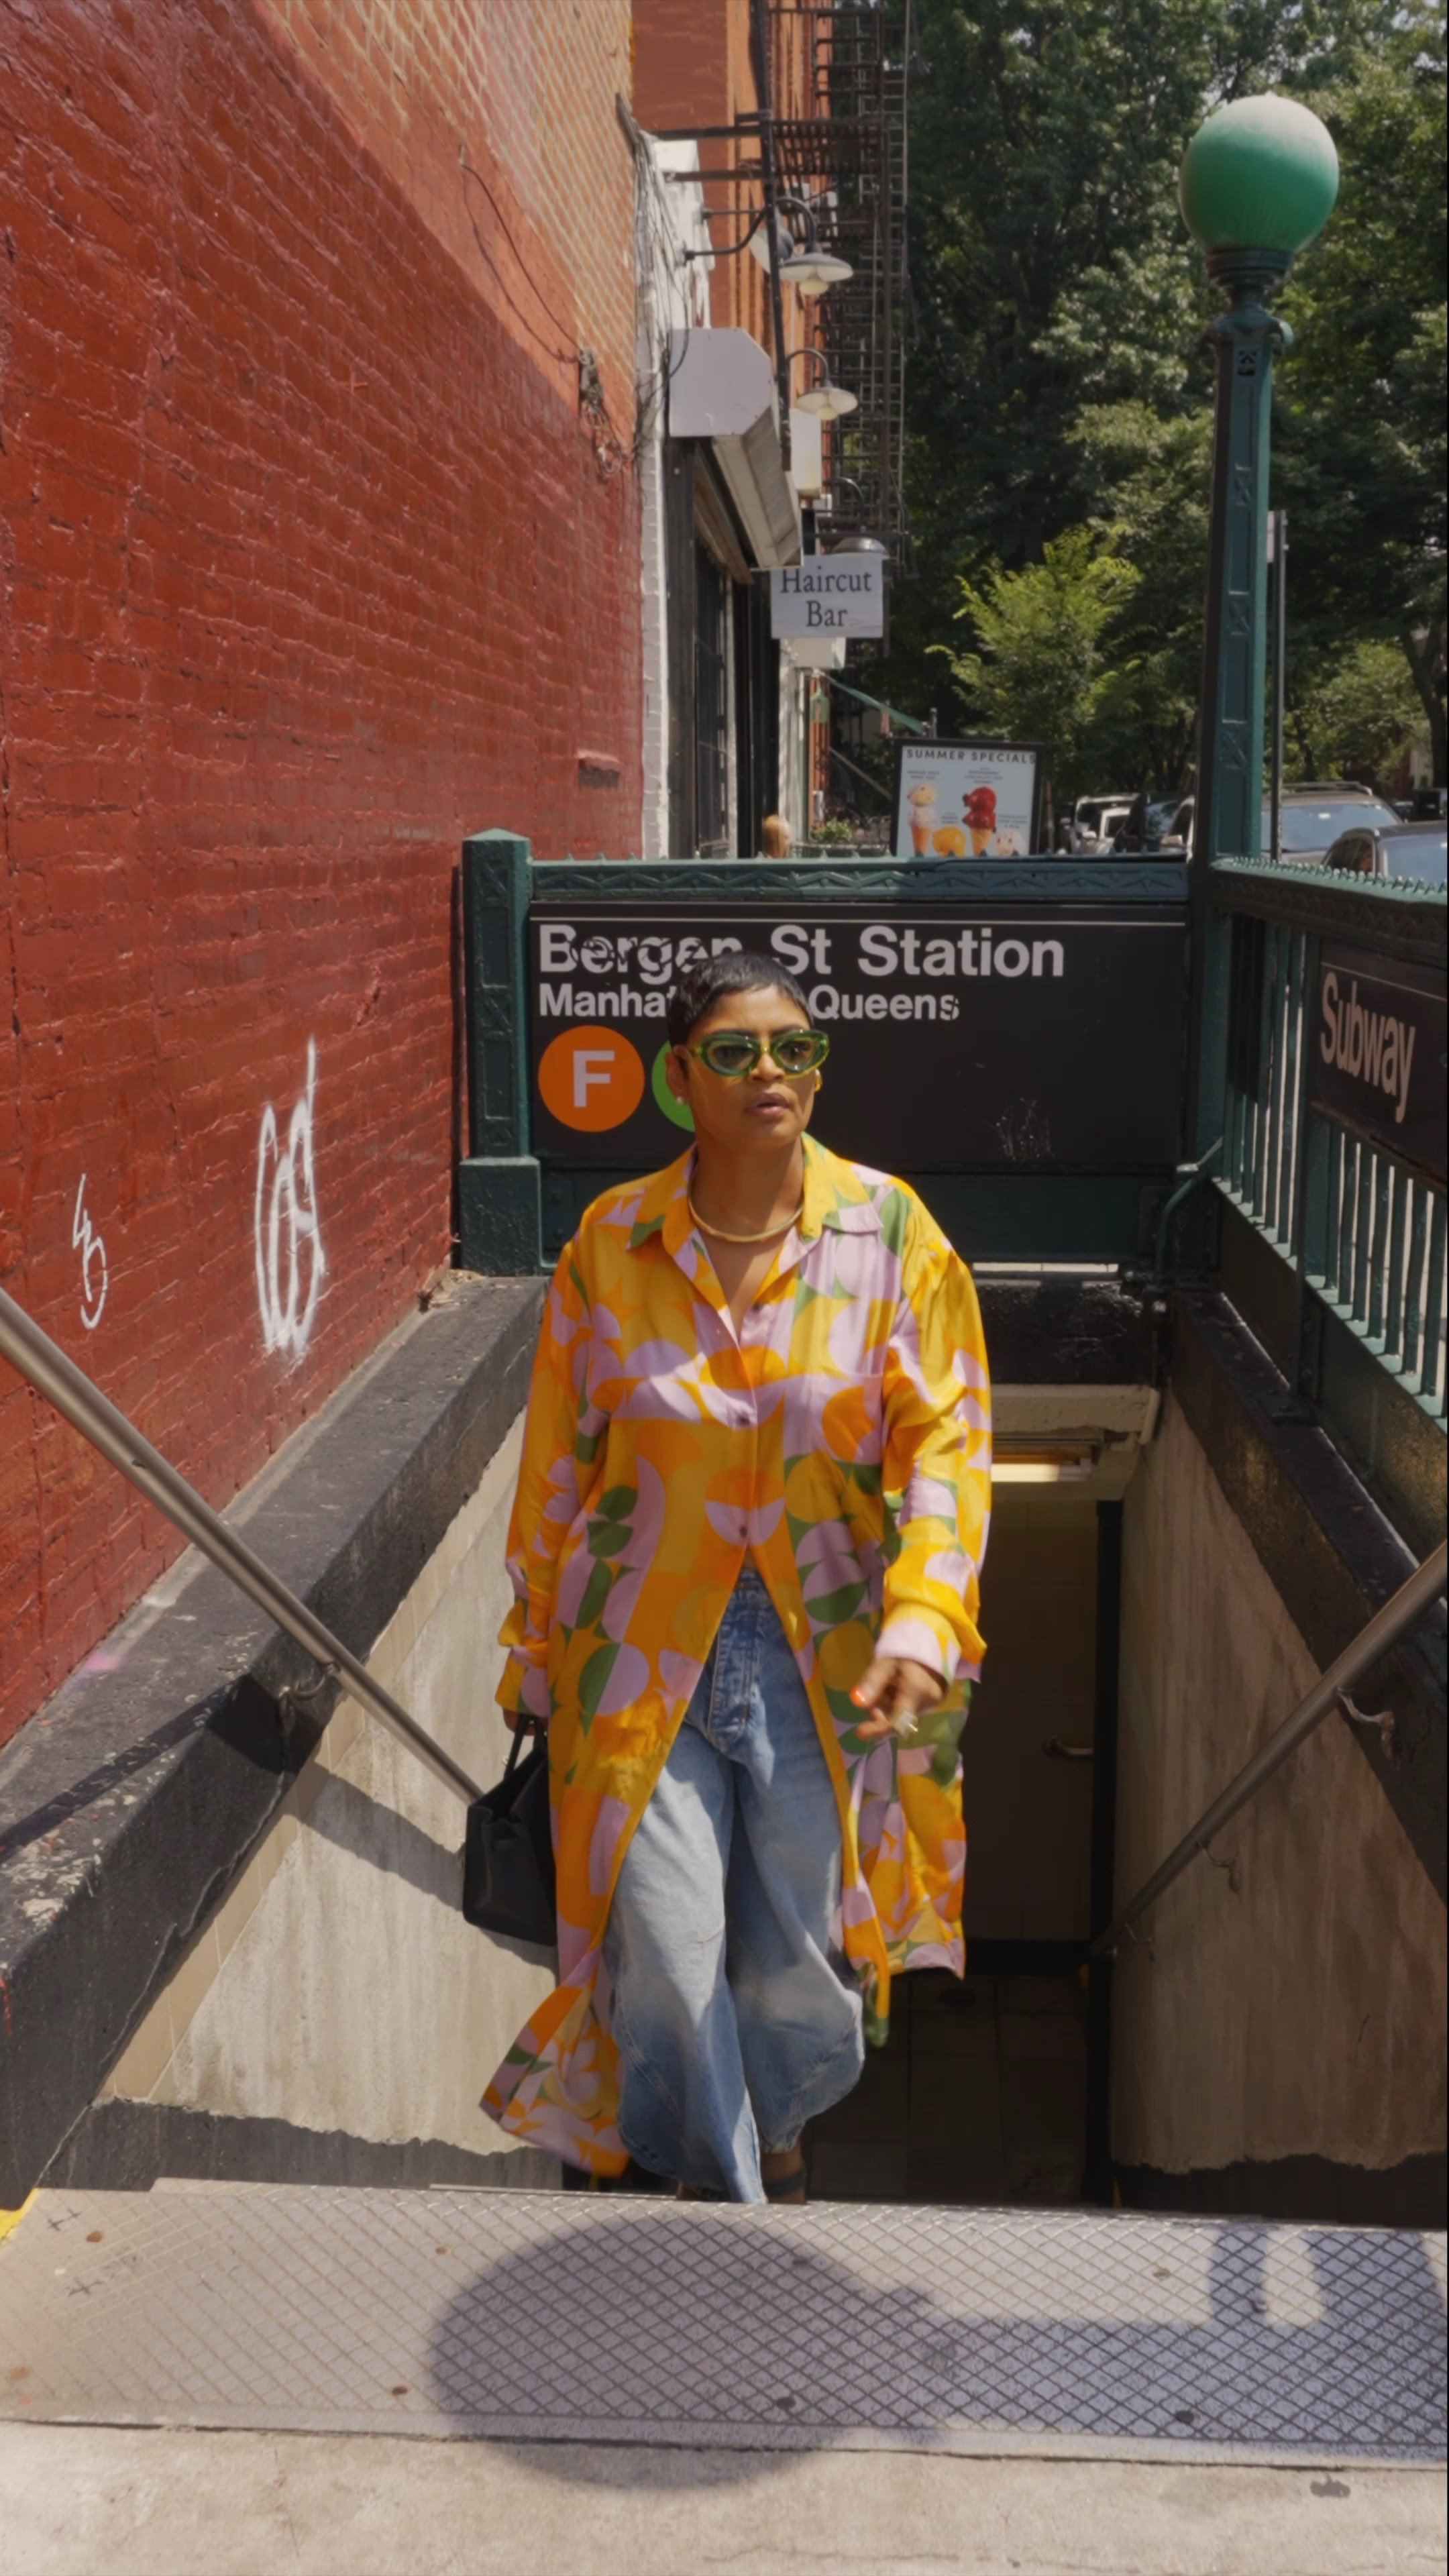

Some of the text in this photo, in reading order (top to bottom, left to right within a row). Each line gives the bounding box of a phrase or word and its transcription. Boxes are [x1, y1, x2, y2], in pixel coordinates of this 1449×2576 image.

[780, 566, 871, 593] Haircut
[806, 600, 848, 627] Bar
[906, 749, 1036, 764] SUMMER SPECIALS
[771, 924, 832, 975] St
[858, 925, 1065, 977] Station
[808, 984, 959, 1020] Queens
[1320, 971, 1416, 1124] Subway
[572, 1051, 615, 1108] F
